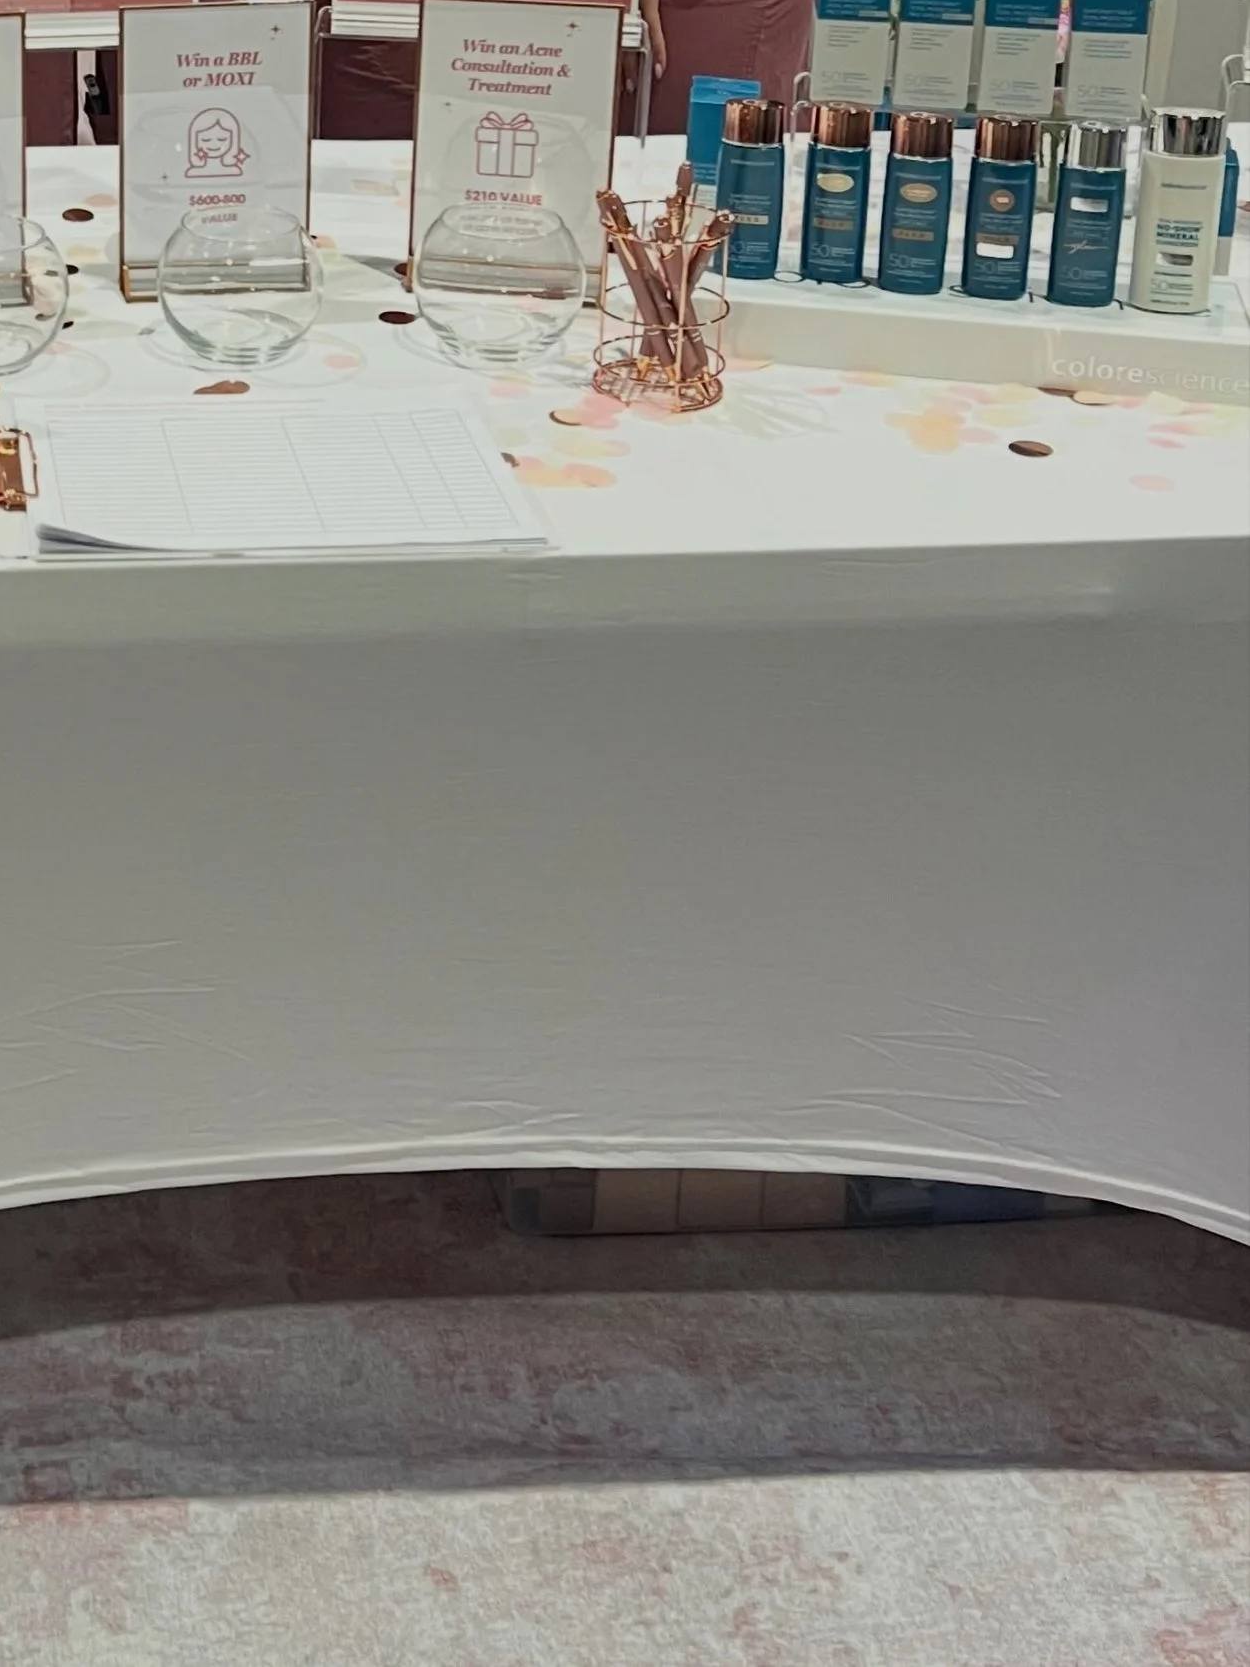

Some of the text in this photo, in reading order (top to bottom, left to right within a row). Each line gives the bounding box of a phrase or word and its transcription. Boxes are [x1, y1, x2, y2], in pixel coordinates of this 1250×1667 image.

[463, 38, 563, 57] Win an Acne
[176, 51, 263, 68] Win a BBL
[450, 57, 572, 78] Consultation &
[182, 71, 256, 87] or MOXI
[468, 77, 553, 96] Treatment
[500, 192, 543, 206] VALUE
[1051, 355, 1250, 396] colorescience
